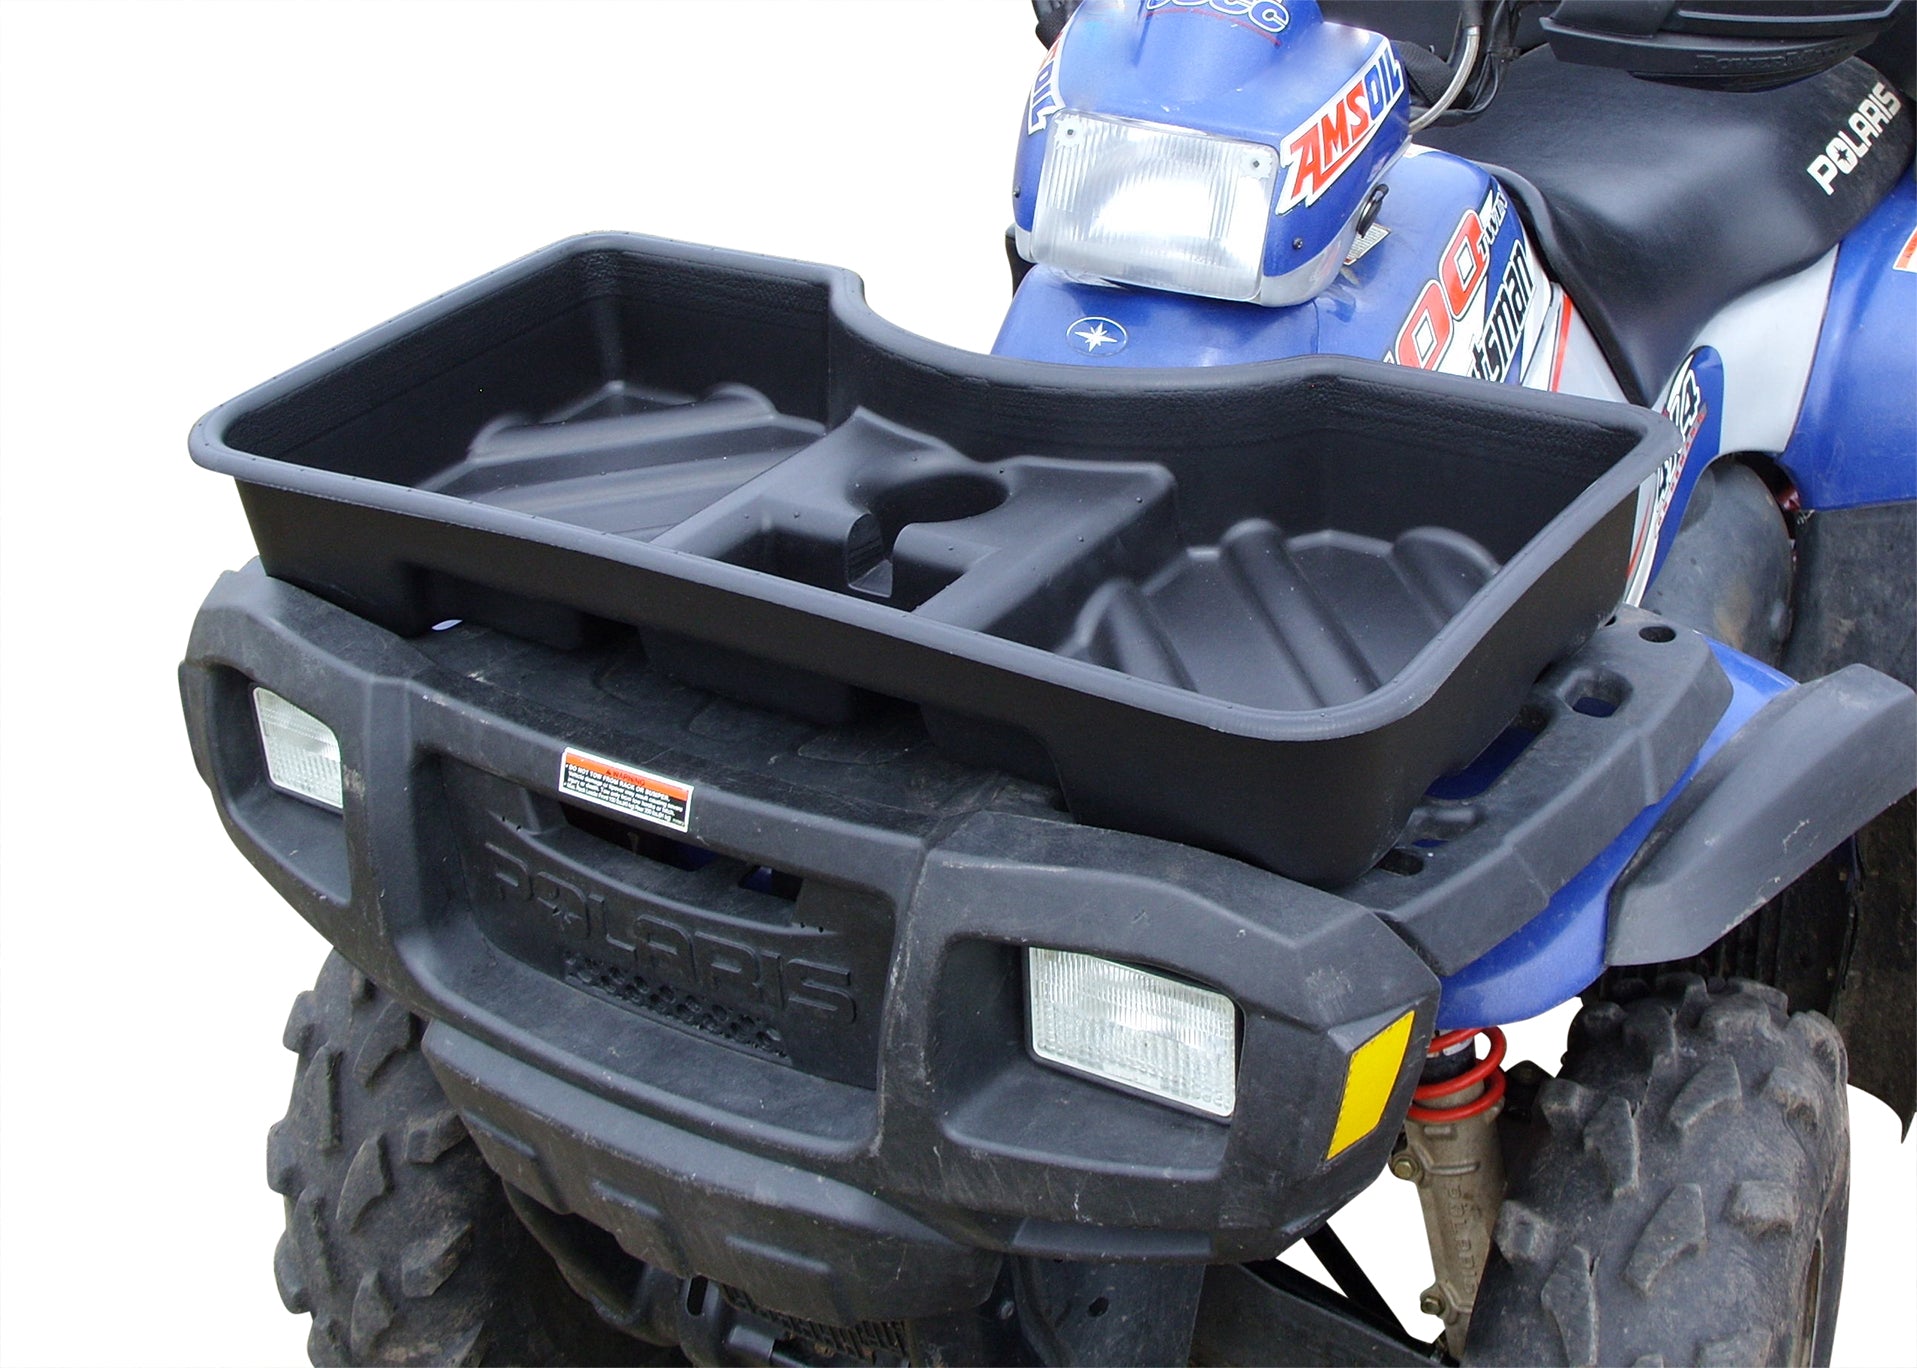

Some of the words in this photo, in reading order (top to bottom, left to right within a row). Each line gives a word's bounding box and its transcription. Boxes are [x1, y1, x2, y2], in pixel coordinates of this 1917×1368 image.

[1288, 48, 1403, 199] AMSOIL
[1806, 81, 1901, 196] POLARIS
[1385, 209, 1490, 371] 00
[1471, 242, 1536, 383] tsman
[577, 767, 588, 775] NOT
[589, 771, 601, 780] TOW
[602, 775, 618, 785] FROM
[619, 780, 634, 790] RACK
[635, 785, 644, 793] OR
[612, 771, 645, 786] WARNING
[485, 842, 857, 1026] POLARIS
